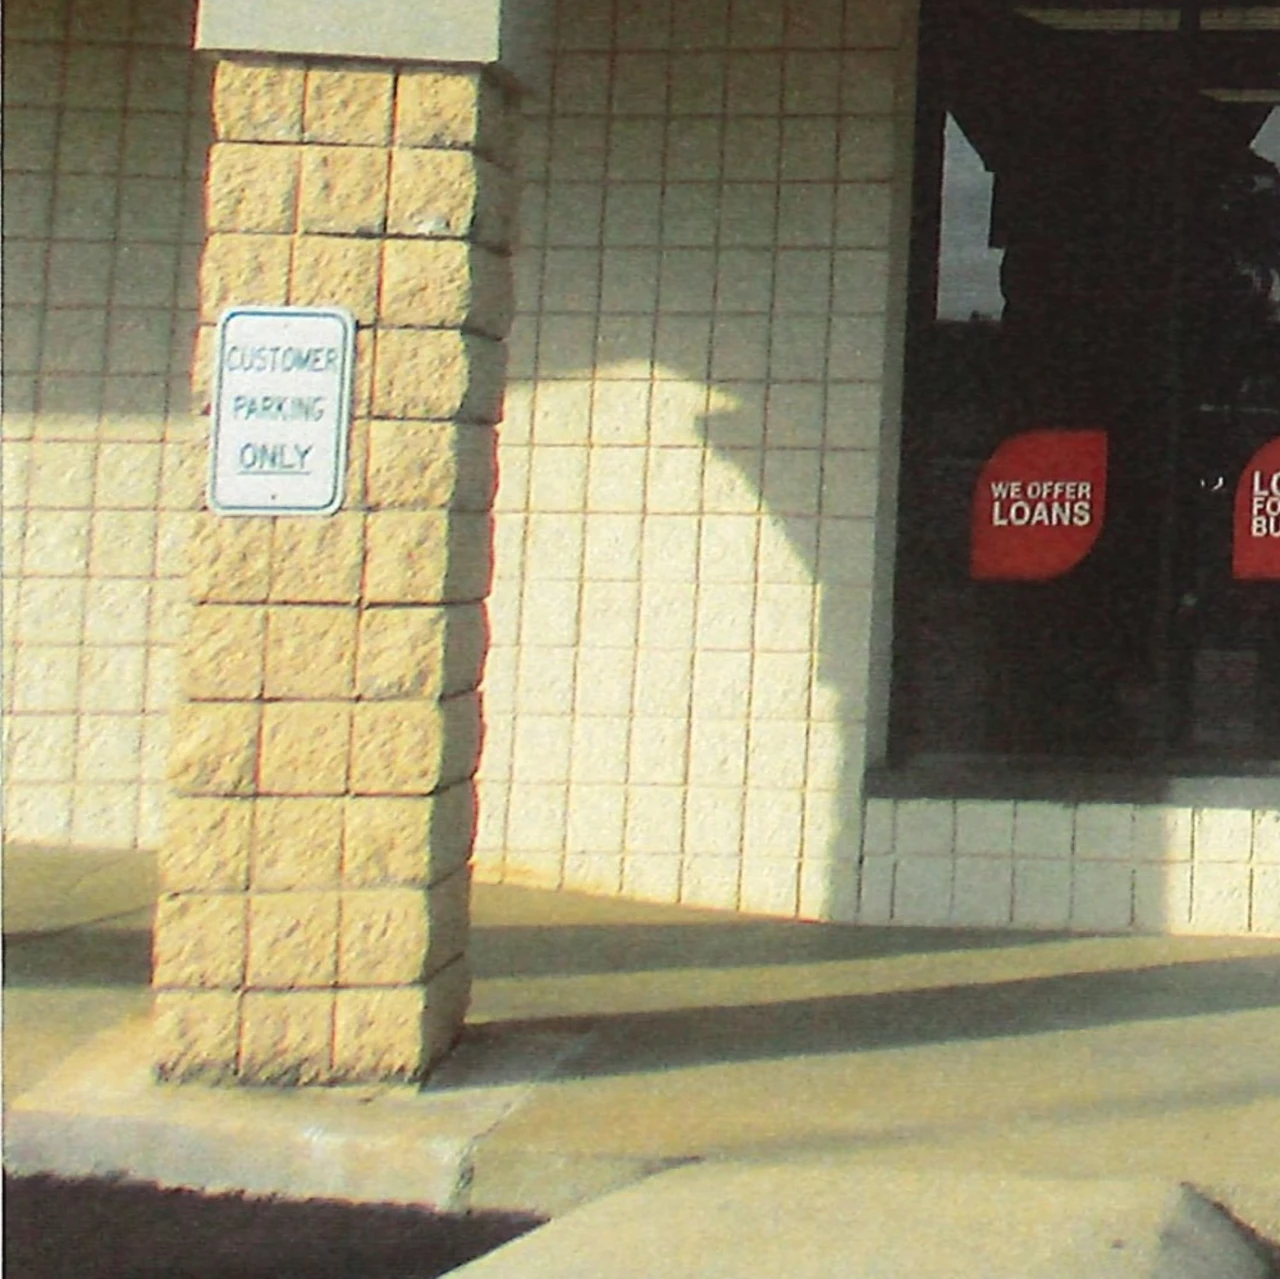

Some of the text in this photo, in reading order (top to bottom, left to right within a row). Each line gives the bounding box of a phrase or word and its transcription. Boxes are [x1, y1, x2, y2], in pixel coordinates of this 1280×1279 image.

[225, 345, 339, 372] CUSTOMER
[232, 394, 325, 421] PARKING
[238, 441, 314, 470] ONLY
[990, 481, 1092, 500] WE OFFER
[992, 501, 1092, 526] LOANS
